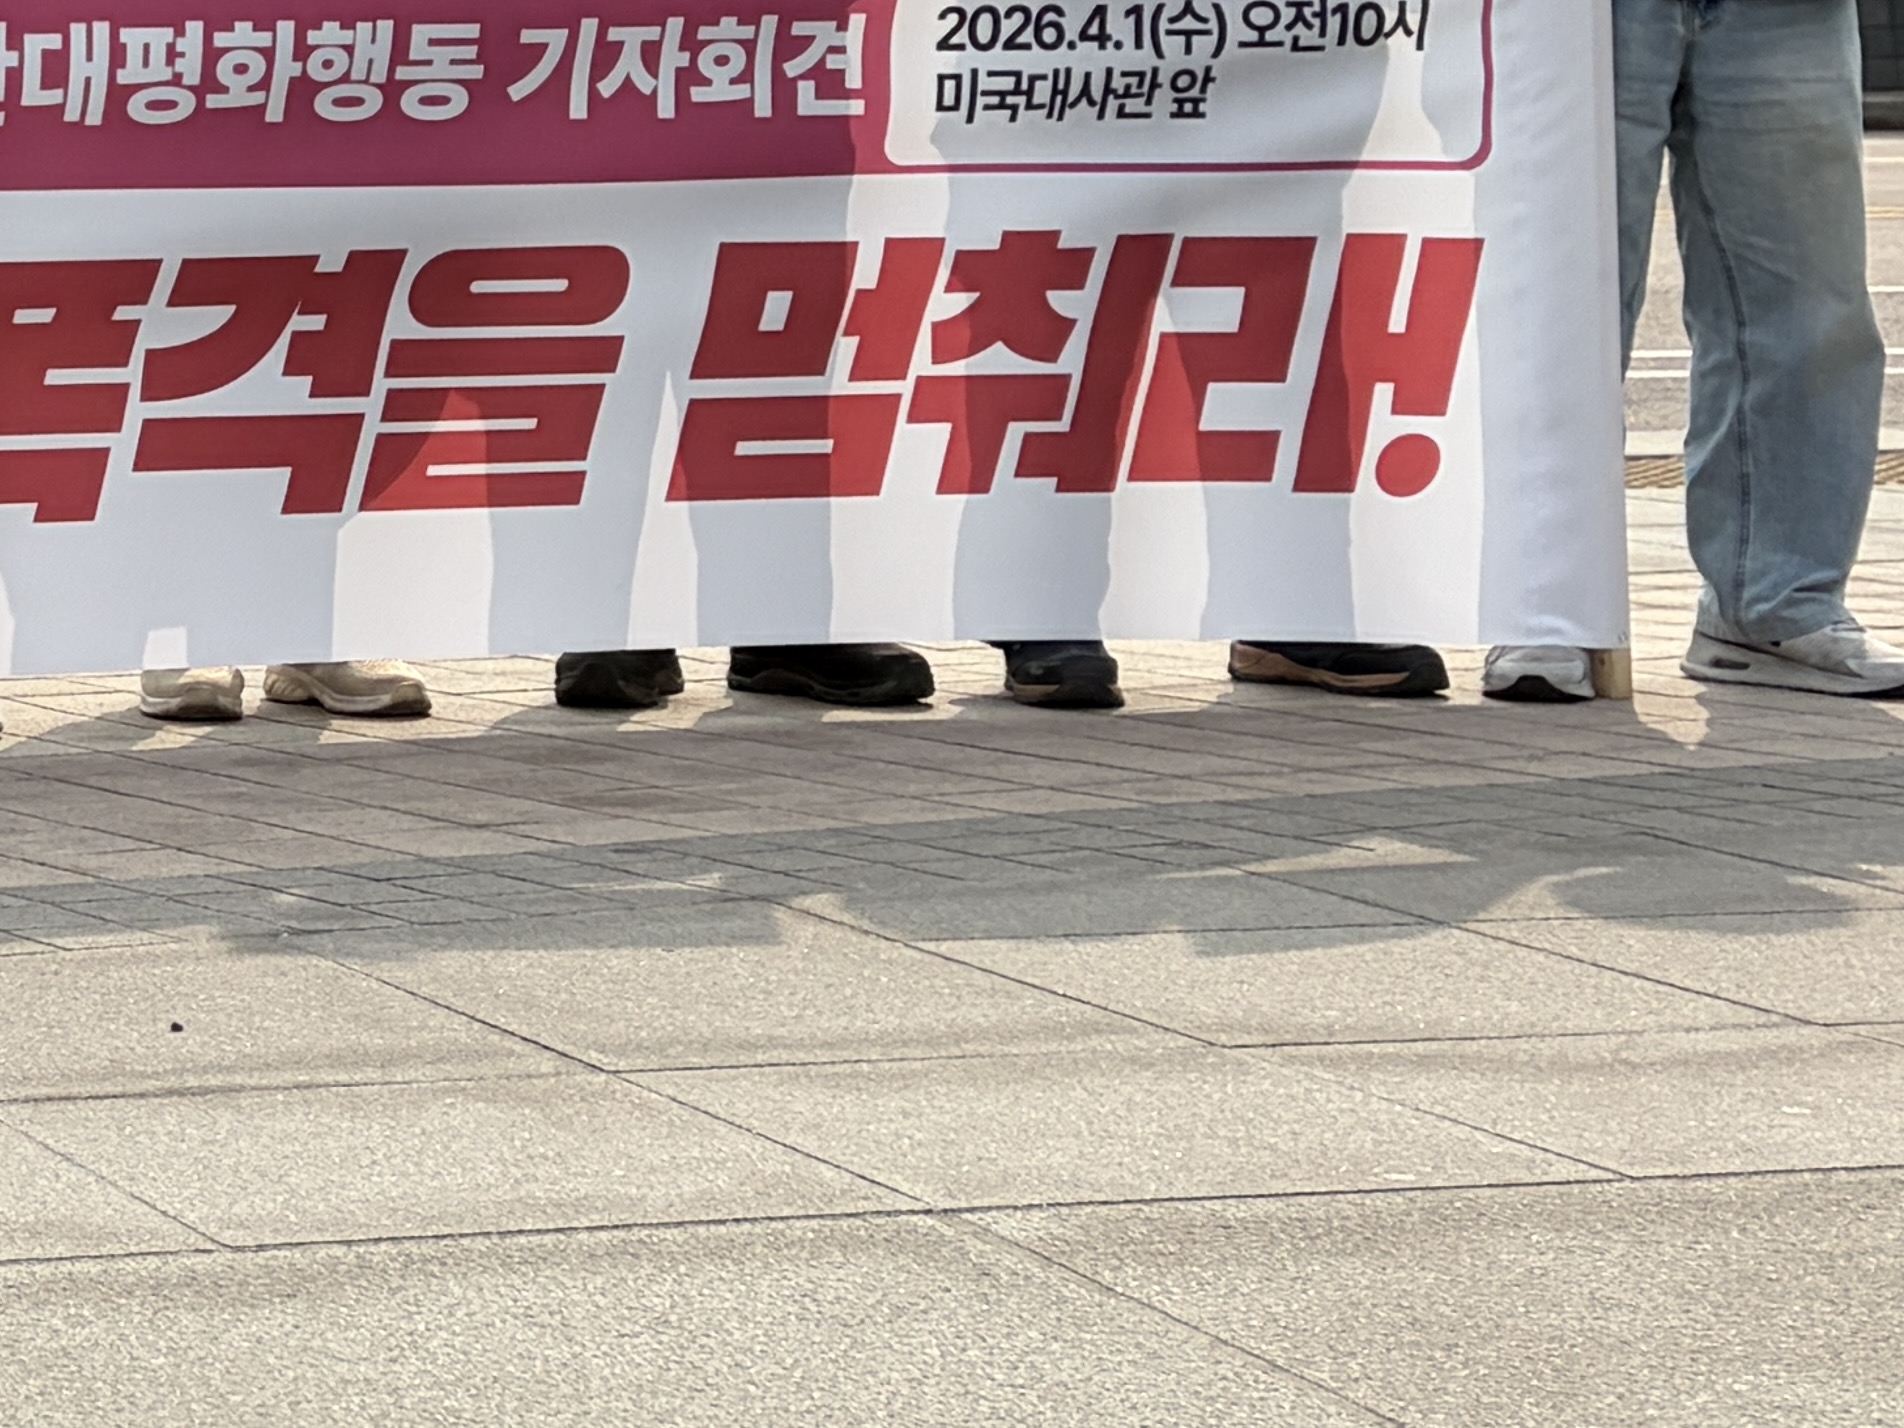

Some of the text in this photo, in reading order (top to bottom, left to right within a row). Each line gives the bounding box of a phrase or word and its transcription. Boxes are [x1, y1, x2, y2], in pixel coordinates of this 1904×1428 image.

[506, 12, 868, 121] 기자회견
[935, 0, 1228, 59] 2026.4.1(수)
[935, 65, 1216, 124] 미국대사관 앞
[665, 231, 1485, 504] 멈춰라!
